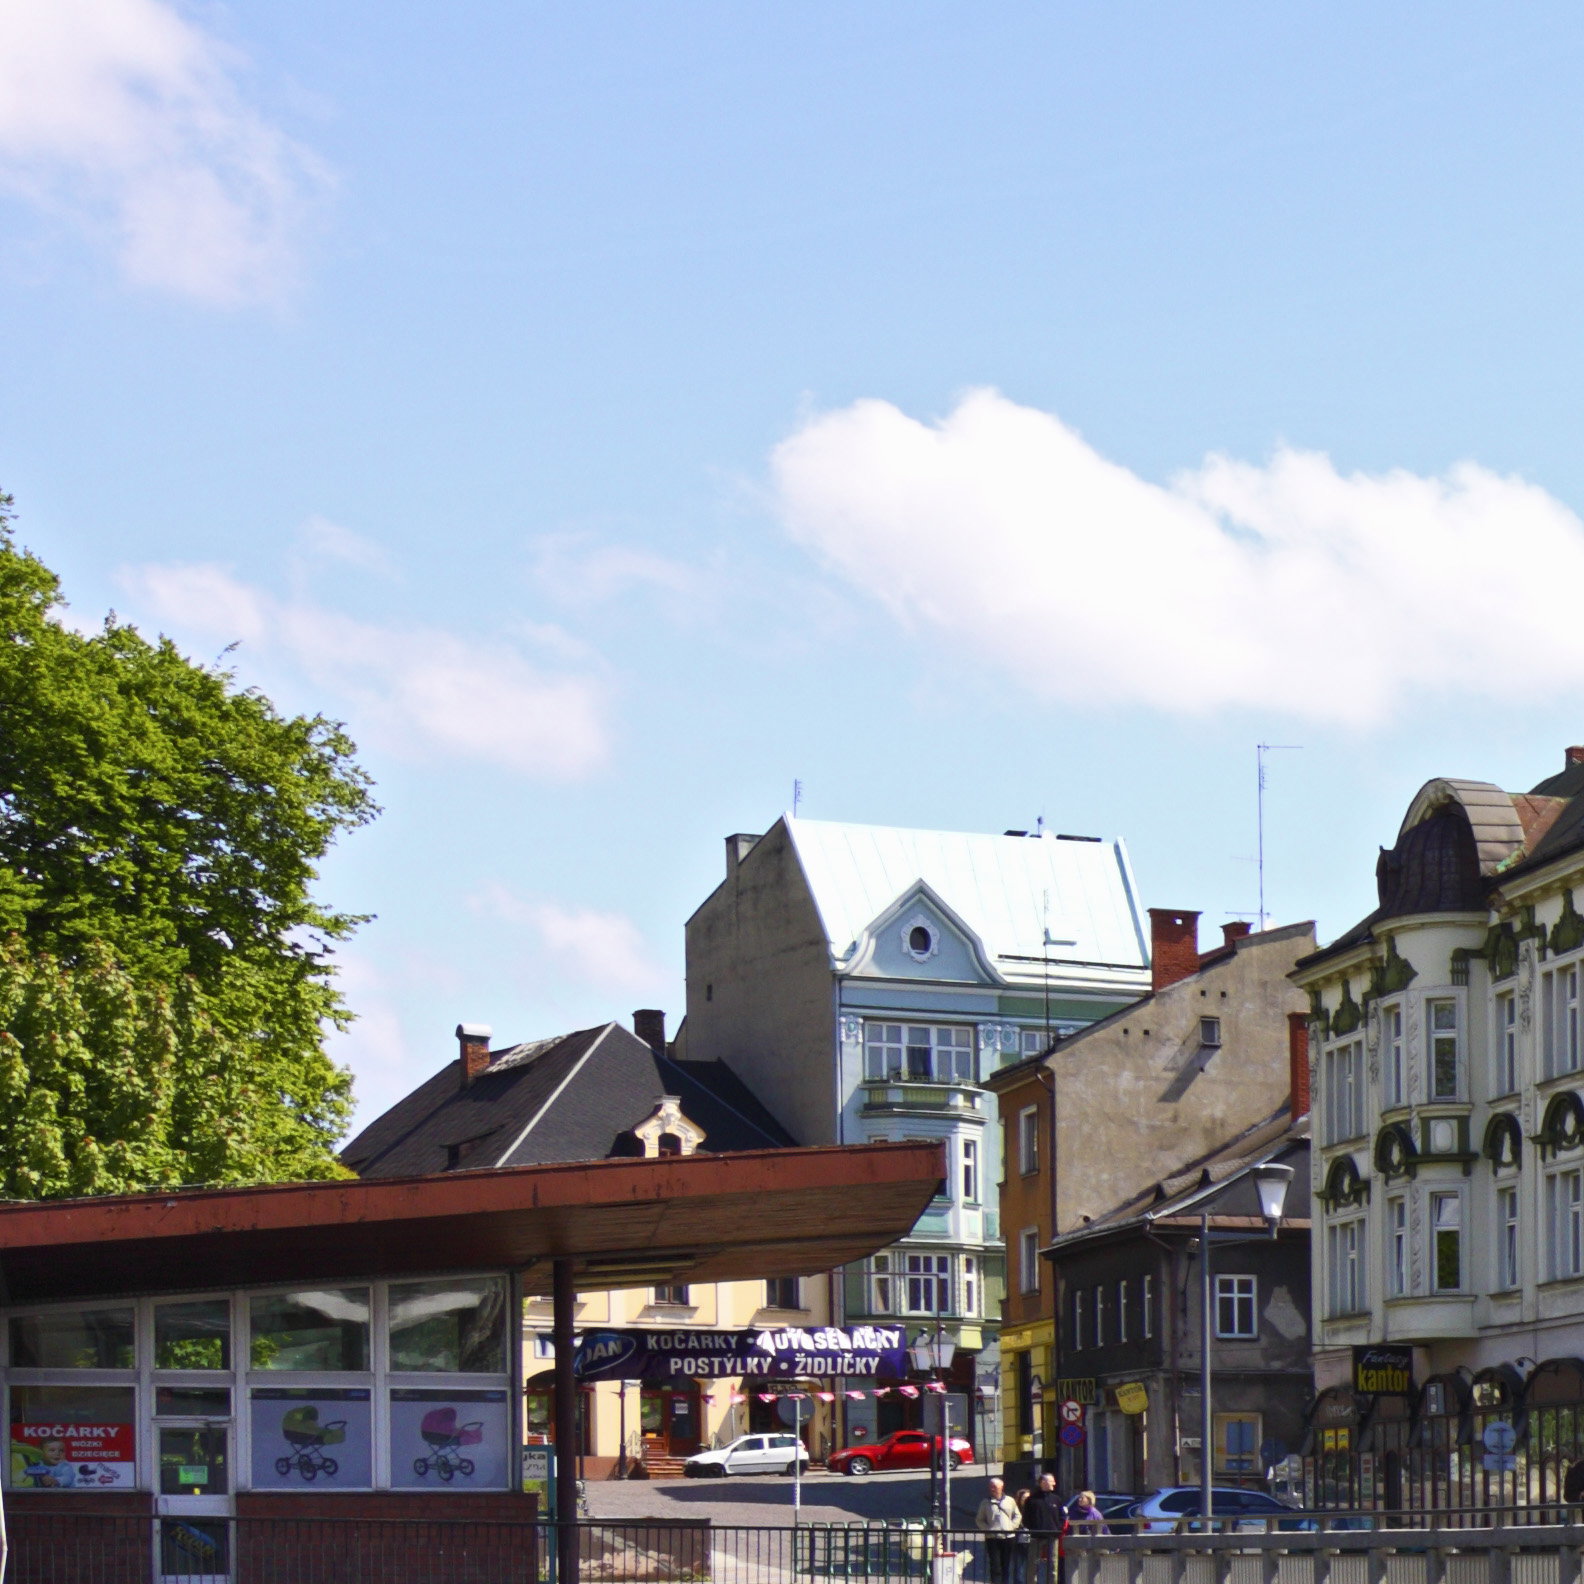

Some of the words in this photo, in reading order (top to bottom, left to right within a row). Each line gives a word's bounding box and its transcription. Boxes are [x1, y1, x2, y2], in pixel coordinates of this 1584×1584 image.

[647, 1331, 738, 1350] KOČÁRKY
[670, 1354, 772, 1375] POSTÝLKY
[794, 1352, 880, 1374] ŽIDLIČKY
[1358, 1362, 1410, 1392] kantor
[24, 1425, 119, 1438] KOČÁRKY
